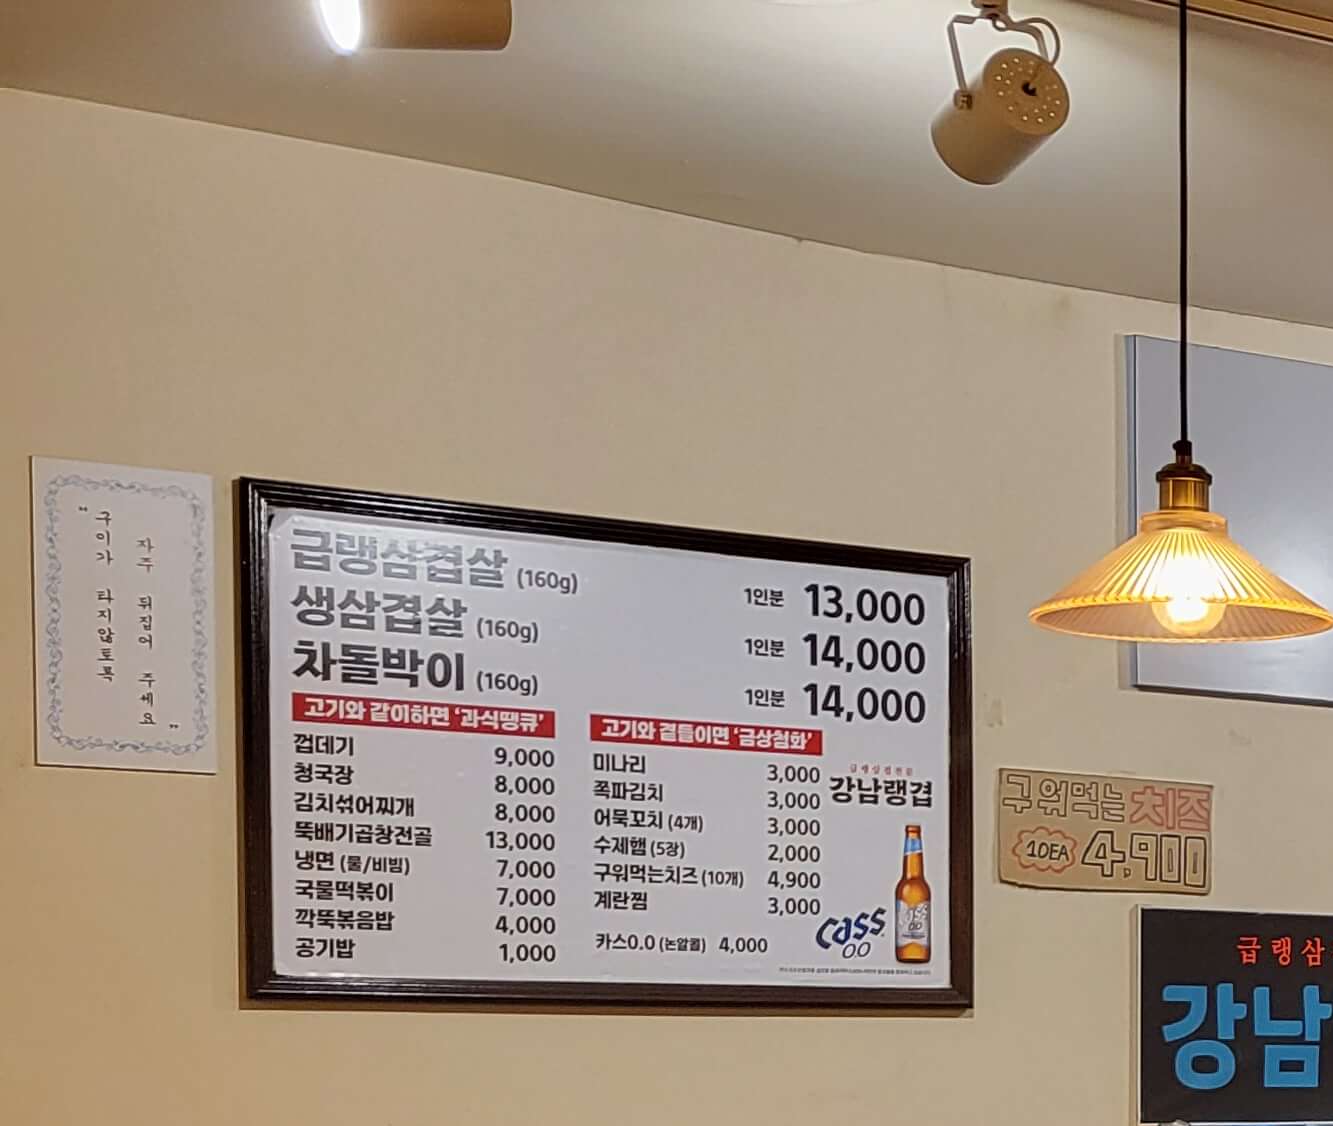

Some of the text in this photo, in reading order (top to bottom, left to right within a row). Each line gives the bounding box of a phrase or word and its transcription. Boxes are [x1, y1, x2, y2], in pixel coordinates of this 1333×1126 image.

[96, 510, 114, 566] 구이가
[137, 537, 155, 573] 자주
[291, 528, 578, 594] 급랭삼겹살 (160g)
[291, 585, 539, 644] 생삼겹살 (160g)
[744, 584, 925, 626] 1인분 13,000
[292, 640, 538, 696] 차돌박이 (160g)
[744, 633, 926, 675] 1인분 14,000
[304, 697, 366, 721] 고기와
[370, 700, 451, 727] 같이하면
[744, 683, 926, 724] 1인분 14,000
[602, 718, 656, 740] 고기와
[293, 733, 555, 768] 껍데기 9,000
[293, 762, 555, 797] 청국장 8,000
[593, 753, 820, 785] 미나리 3,000
[293, 792, 555, 824] 김치섞어찌개 8,000
[593, 781, 821, 811] 쪽파김치 3,000
[829, 776, 932, 808] 강남랭겹
[294, 821, 555, 852] 뚝배기곱창전골 13,000
[594, 809, 821, 838] 어묵꼬치 (4개) 3,000
[294, 851, 335, 872] 냉면
[496, 860, 556, 880] 7,000
[594, 836, 821, 864] 수제햄 (5장) 2,000
[594, 863, 821, 891] 구워먹는치즈 (10개) 4,900
[295, 880, 556, 908] 국물떡볶이 7,000
[594, 891, 821, 917] 계란찜 3,000
[495, 915, 556, 936] 4,000
[816, 907, 887, 949] Cass
[296, 938, 556, 963] 공기밥 1,000
[596, 934, 655, 952] 카스0.0
[718, 936, 768, 954] 4,000
